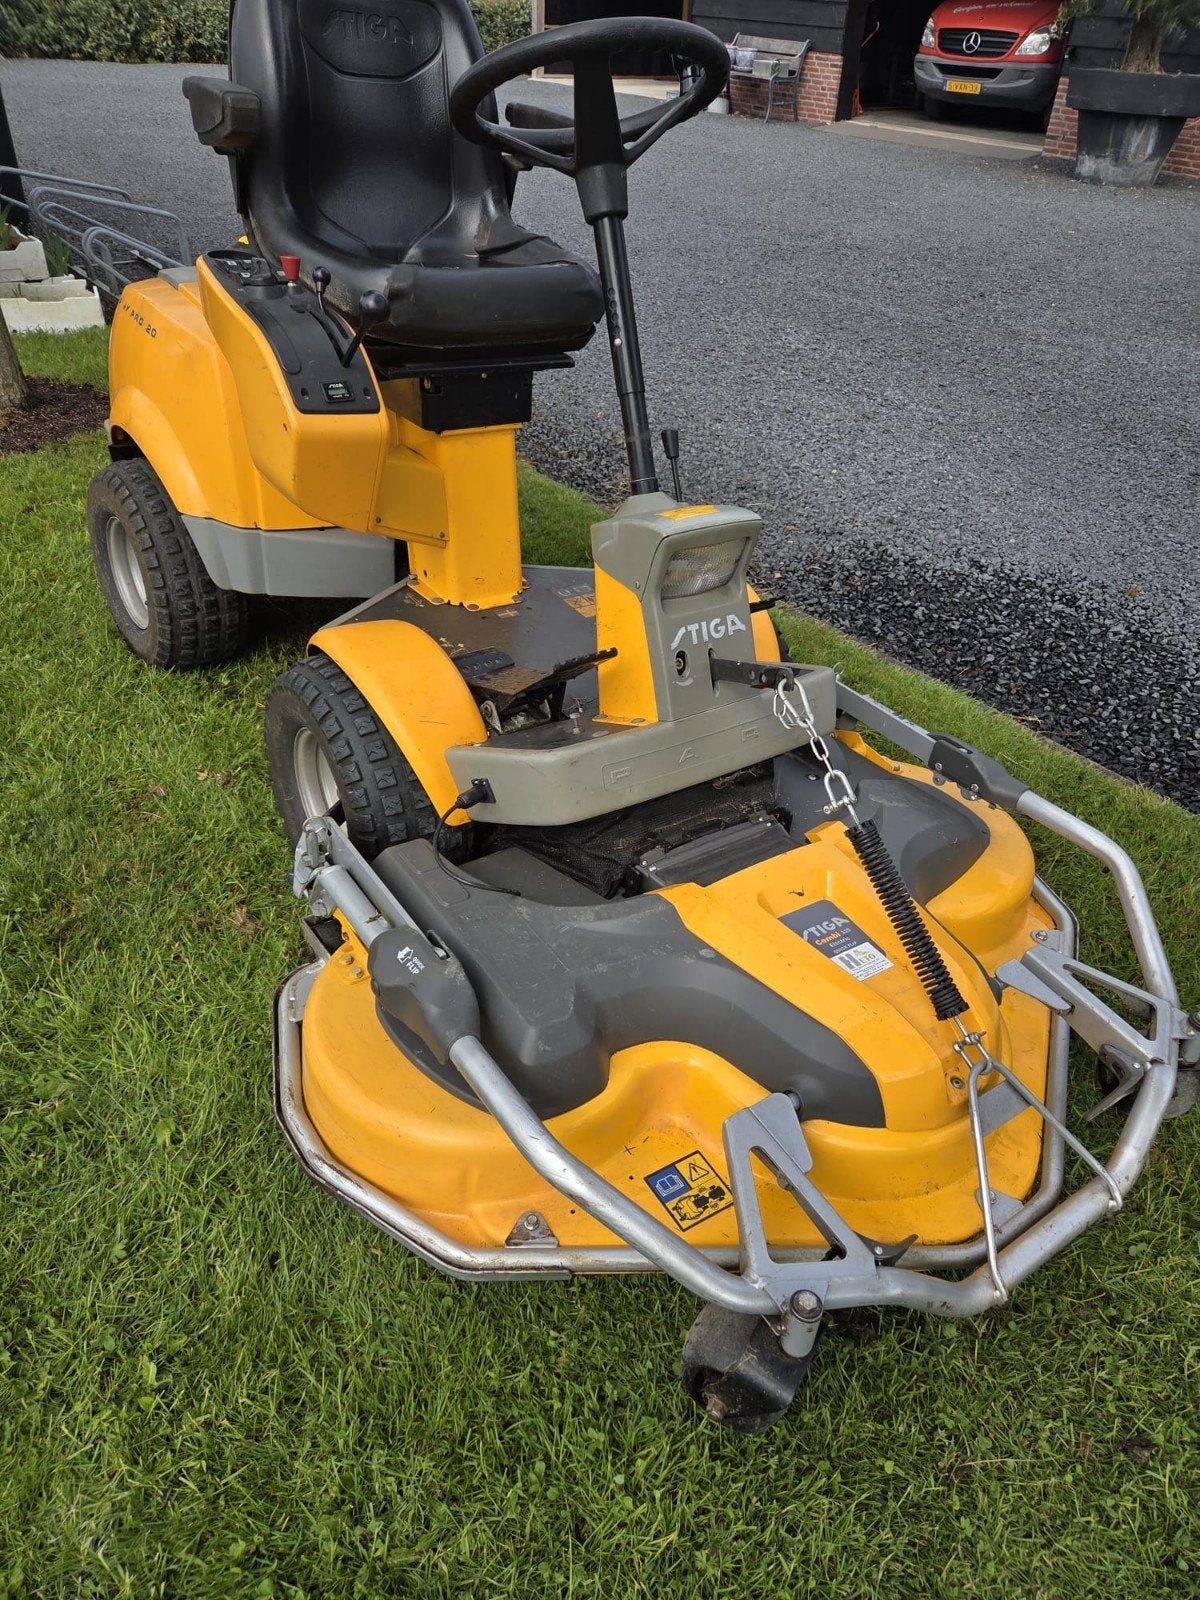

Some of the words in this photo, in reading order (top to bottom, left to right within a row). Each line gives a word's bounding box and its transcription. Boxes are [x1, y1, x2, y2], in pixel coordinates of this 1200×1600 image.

[321, 10, 414, 46] STIGA
[146, 324, 157, 338] 20
[671, 614, 746, 650] STIGA
[803, 917, 850, 941] STIGA
[815, 931, 842, 946] Combi
[406, 961, 420, 974] FLIP
